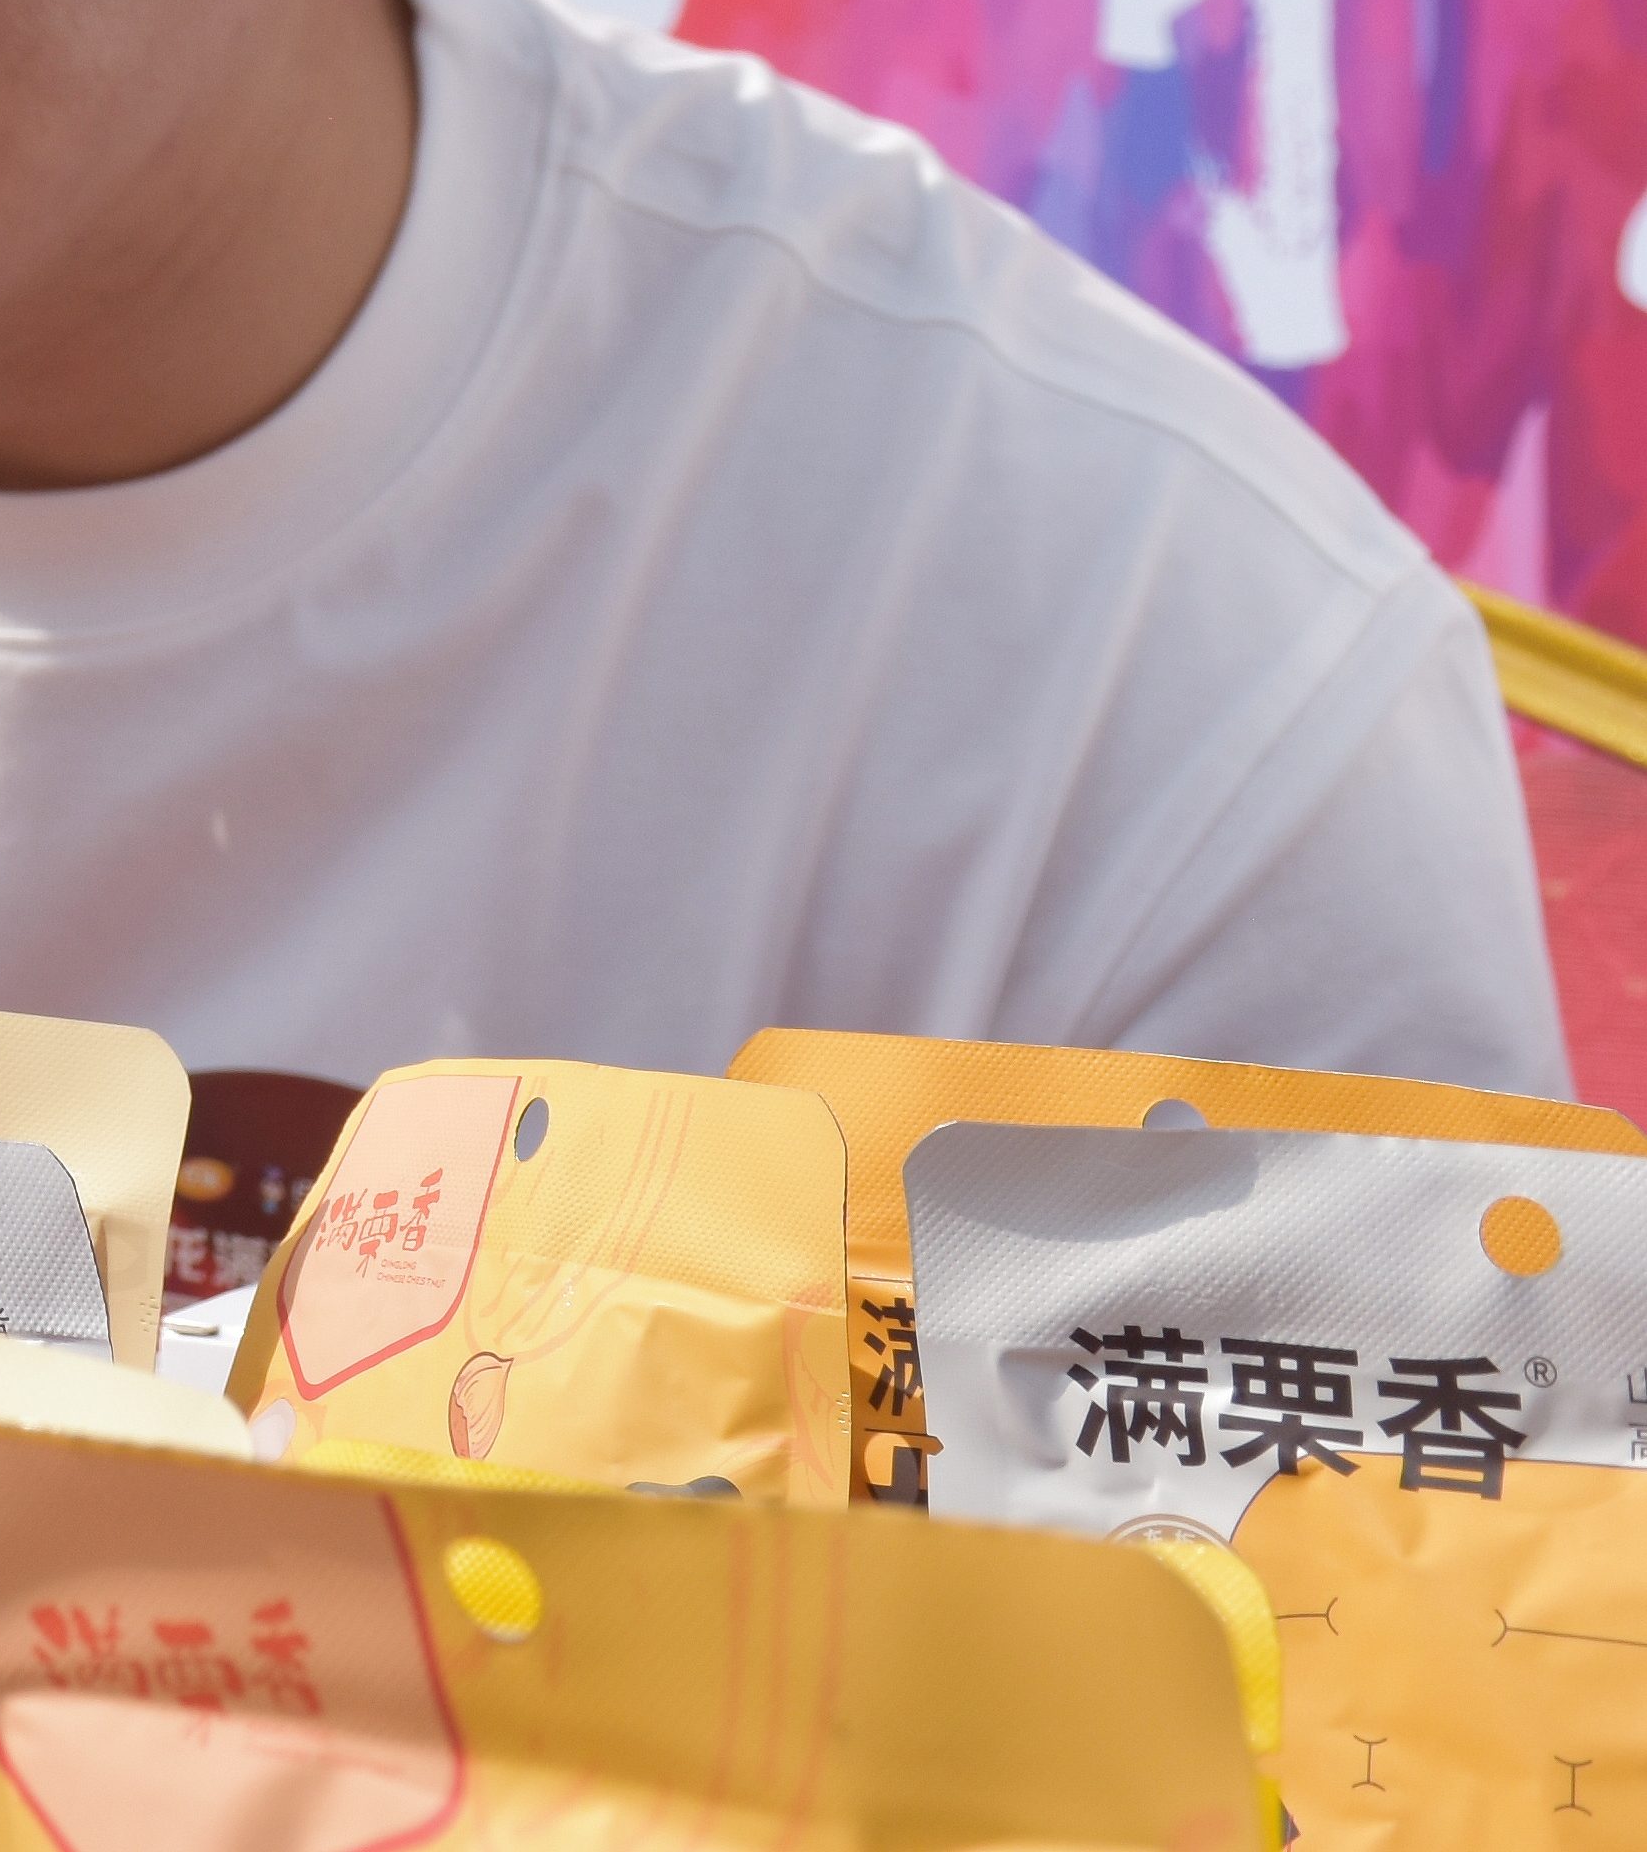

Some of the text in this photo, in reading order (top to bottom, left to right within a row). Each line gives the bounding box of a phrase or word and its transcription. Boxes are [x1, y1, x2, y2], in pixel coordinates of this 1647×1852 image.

[316, 1168, 443, 1278] 满栗香
[1067, 1325, 1527, 1500] 满栗香
